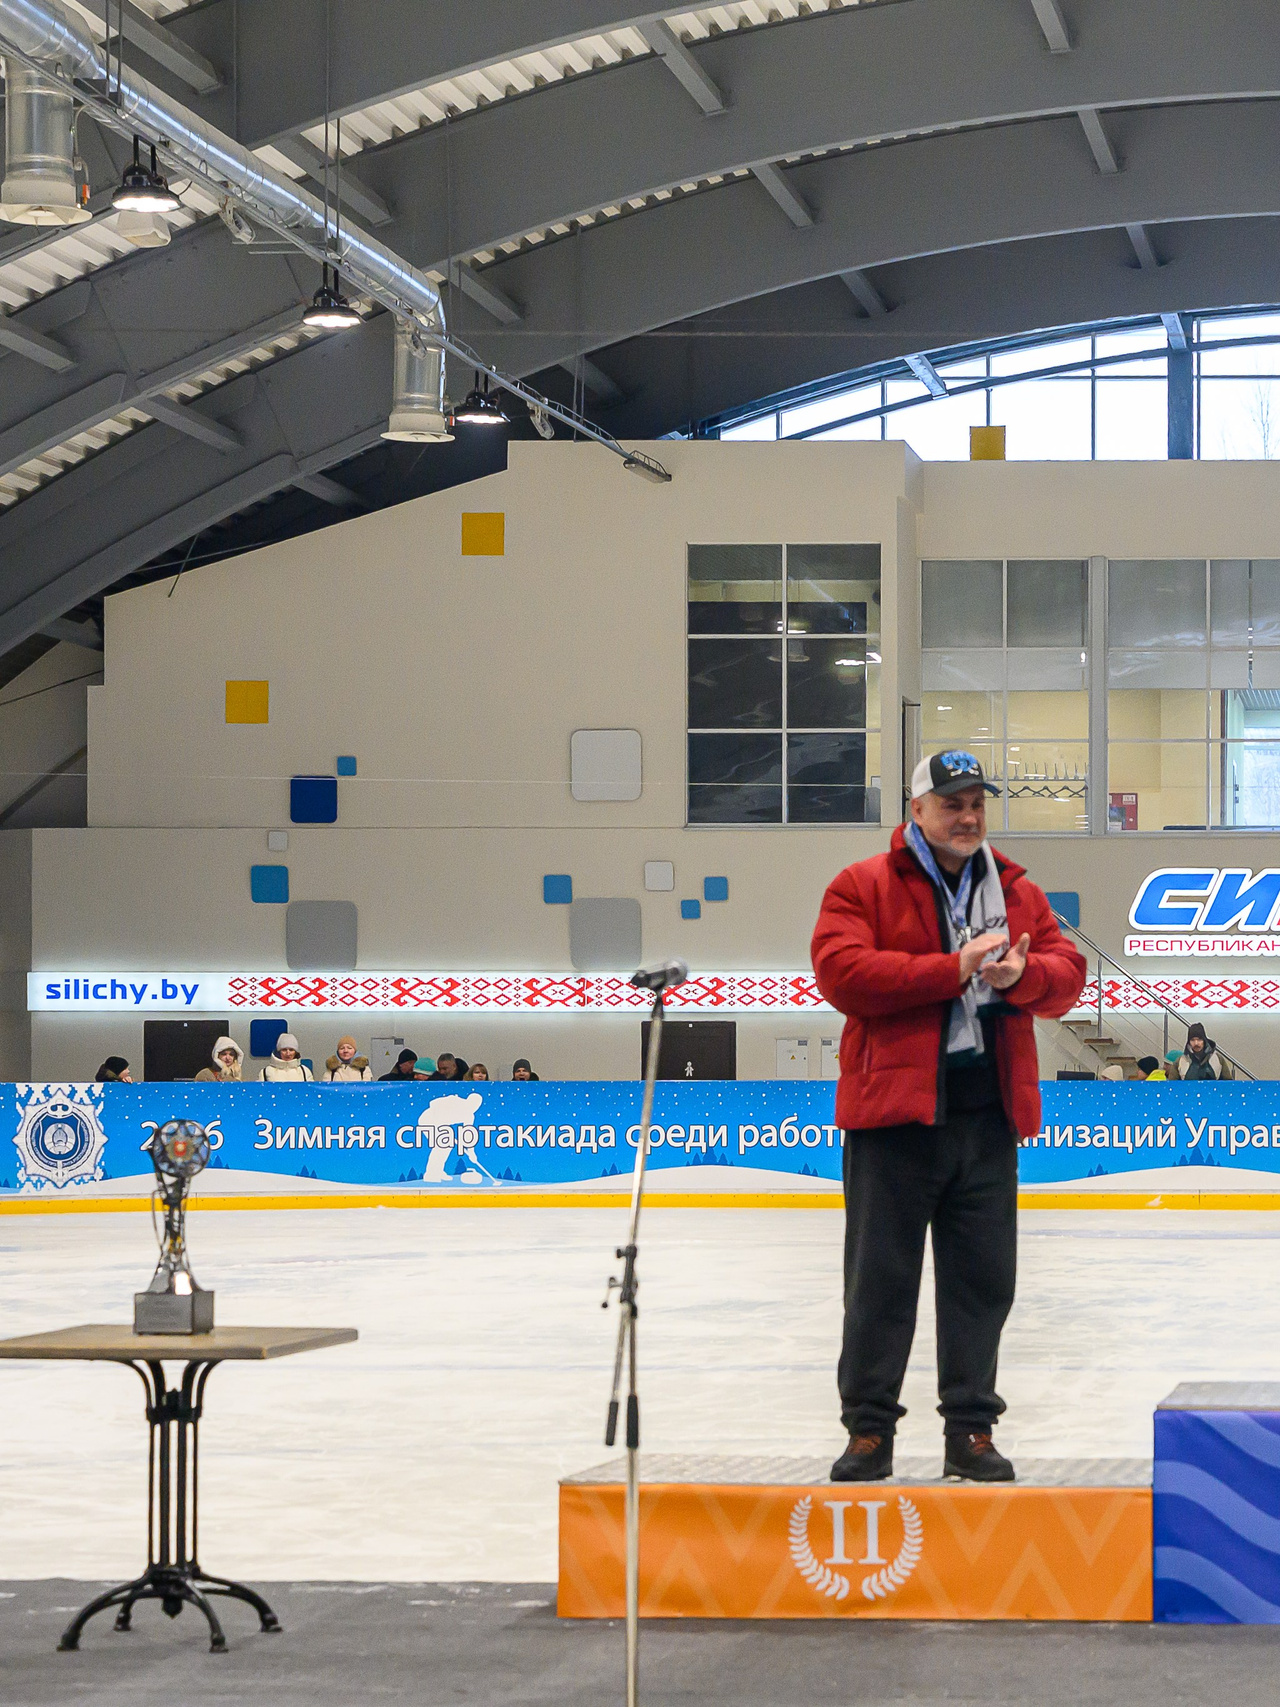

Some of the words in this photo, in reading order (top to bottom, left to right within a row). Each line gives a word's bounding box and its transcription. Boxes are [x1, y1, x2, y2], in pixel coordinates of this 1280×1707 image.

[45, 978, 200, 1005] silichy.by
[139, 1120, 224, 1151] 26
[253, 1118, 387, 1150] Зимняя
[395, 1123, 617, 1157] спартакиада
[624, 1123, 729, 1156] среди
[1016, 1116, 1178, 1154] низаций
[822, 1500, 889, 1565] II
